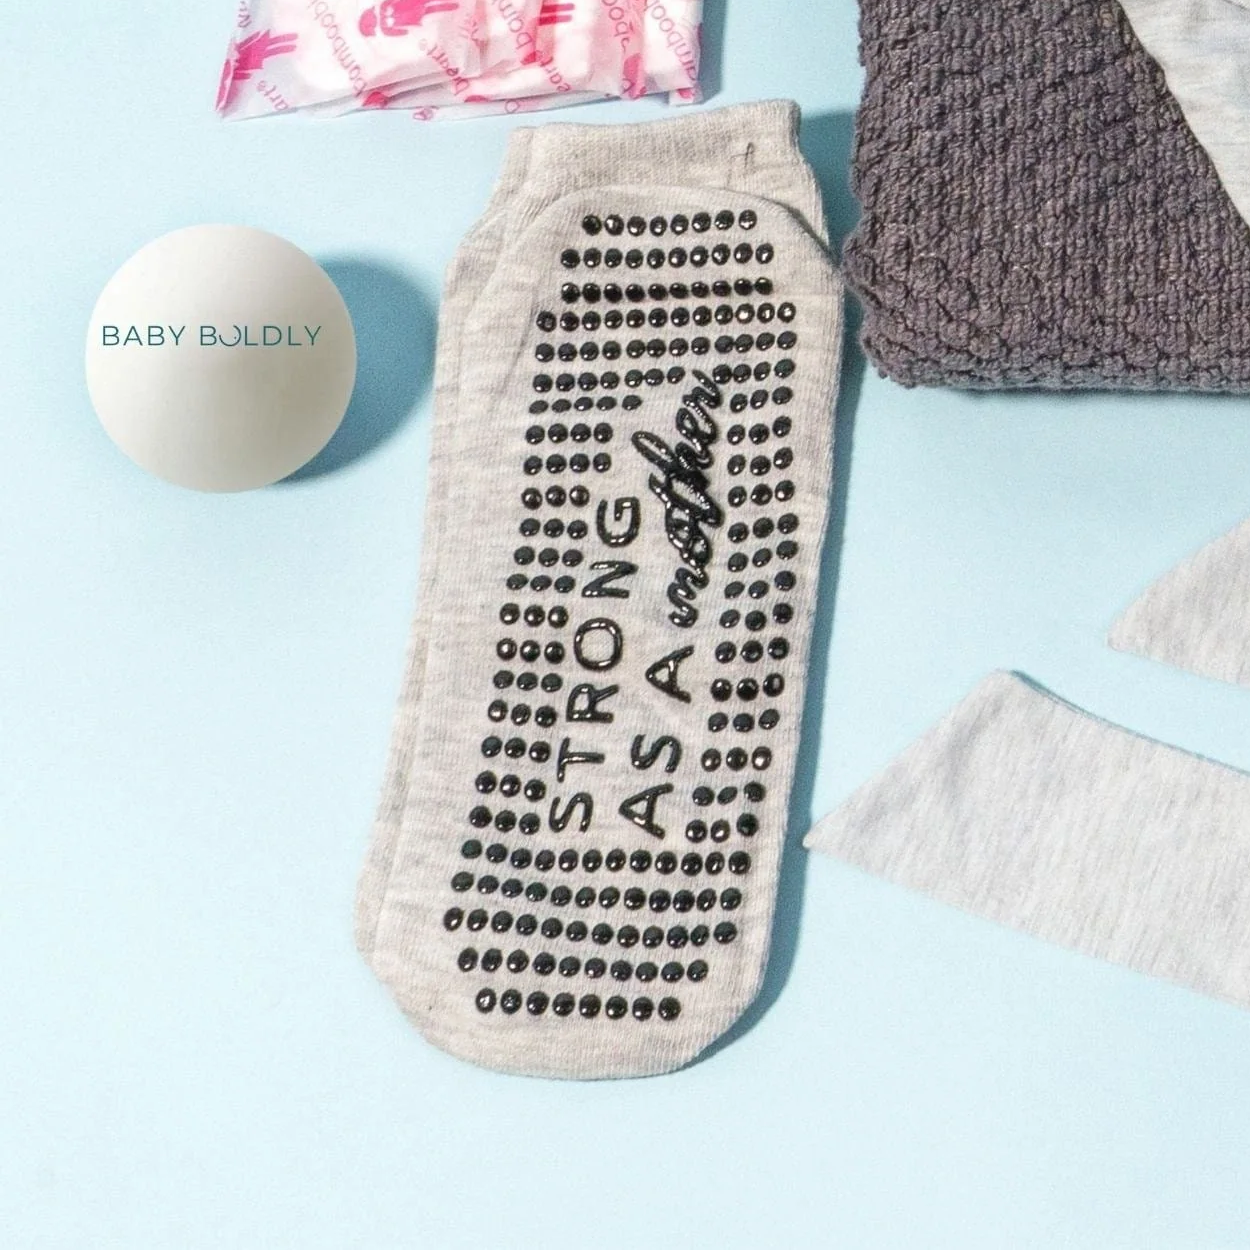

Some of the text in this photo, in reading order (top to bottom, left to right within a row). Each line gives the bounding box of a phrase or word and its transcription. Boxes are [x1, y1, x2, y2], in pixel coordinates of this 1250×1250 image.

[102, 325, 323, 348] BABY BOLDLY
[549, 496, 641, 834] STRONG
[619, 370, 725, 840] AS A mother
